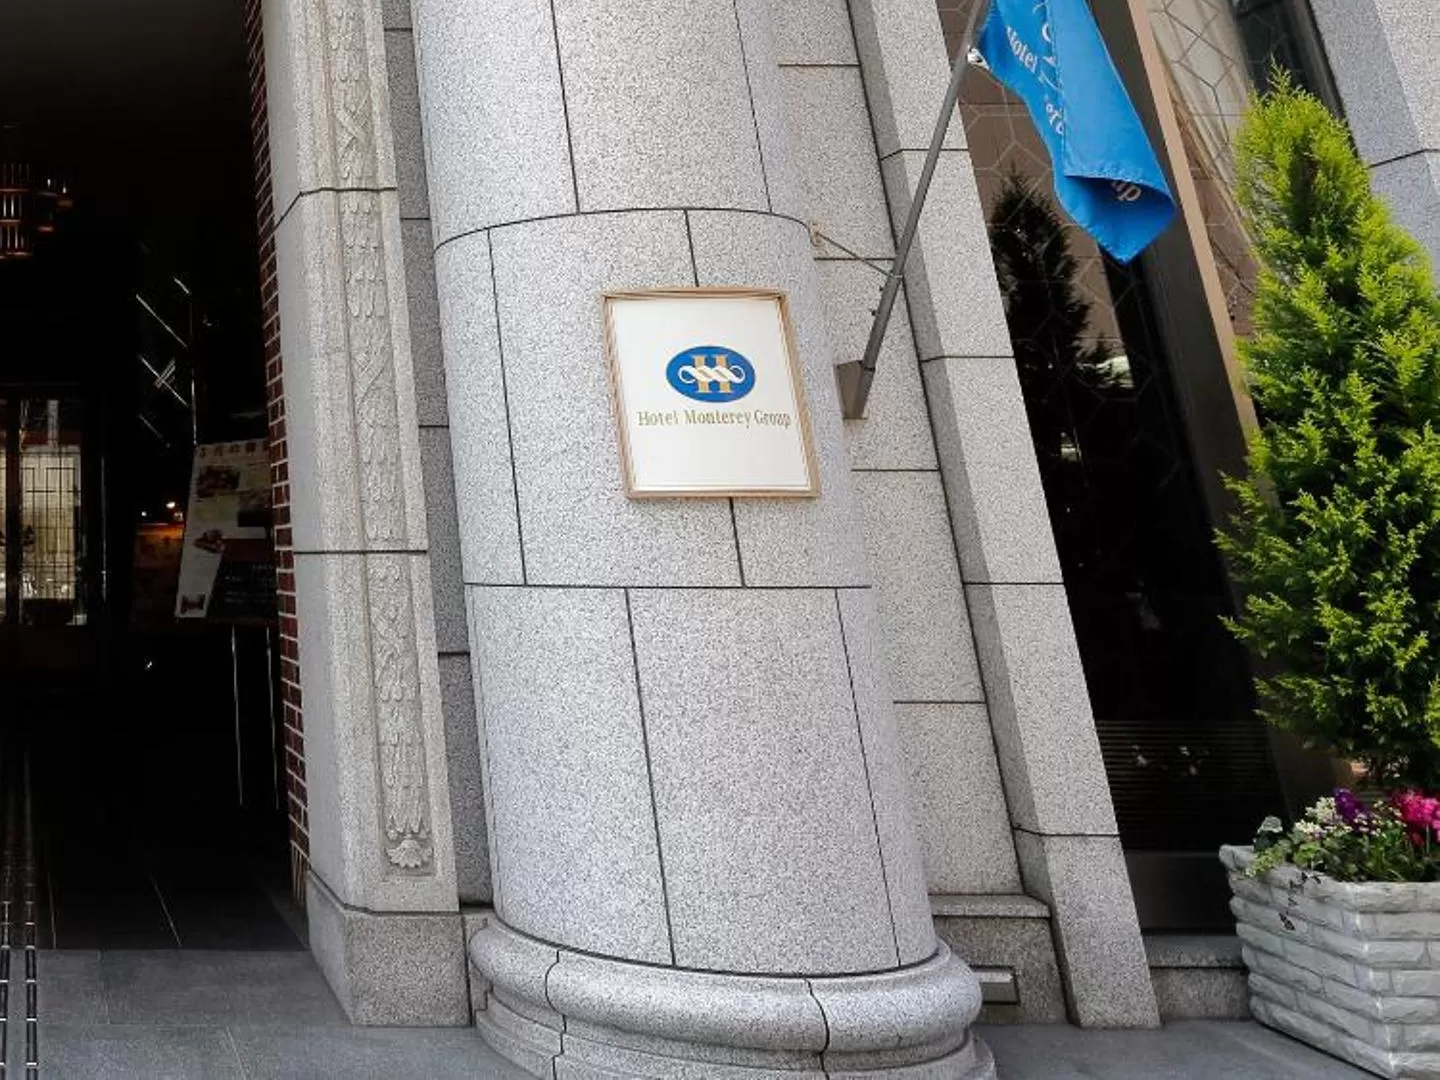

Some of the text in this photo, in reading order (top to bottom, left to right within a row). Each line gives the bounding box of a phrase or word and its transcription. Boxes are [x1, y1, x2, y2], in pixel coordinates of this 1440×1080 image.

[637, 409, 793, 430] Hotel Monterey Group
